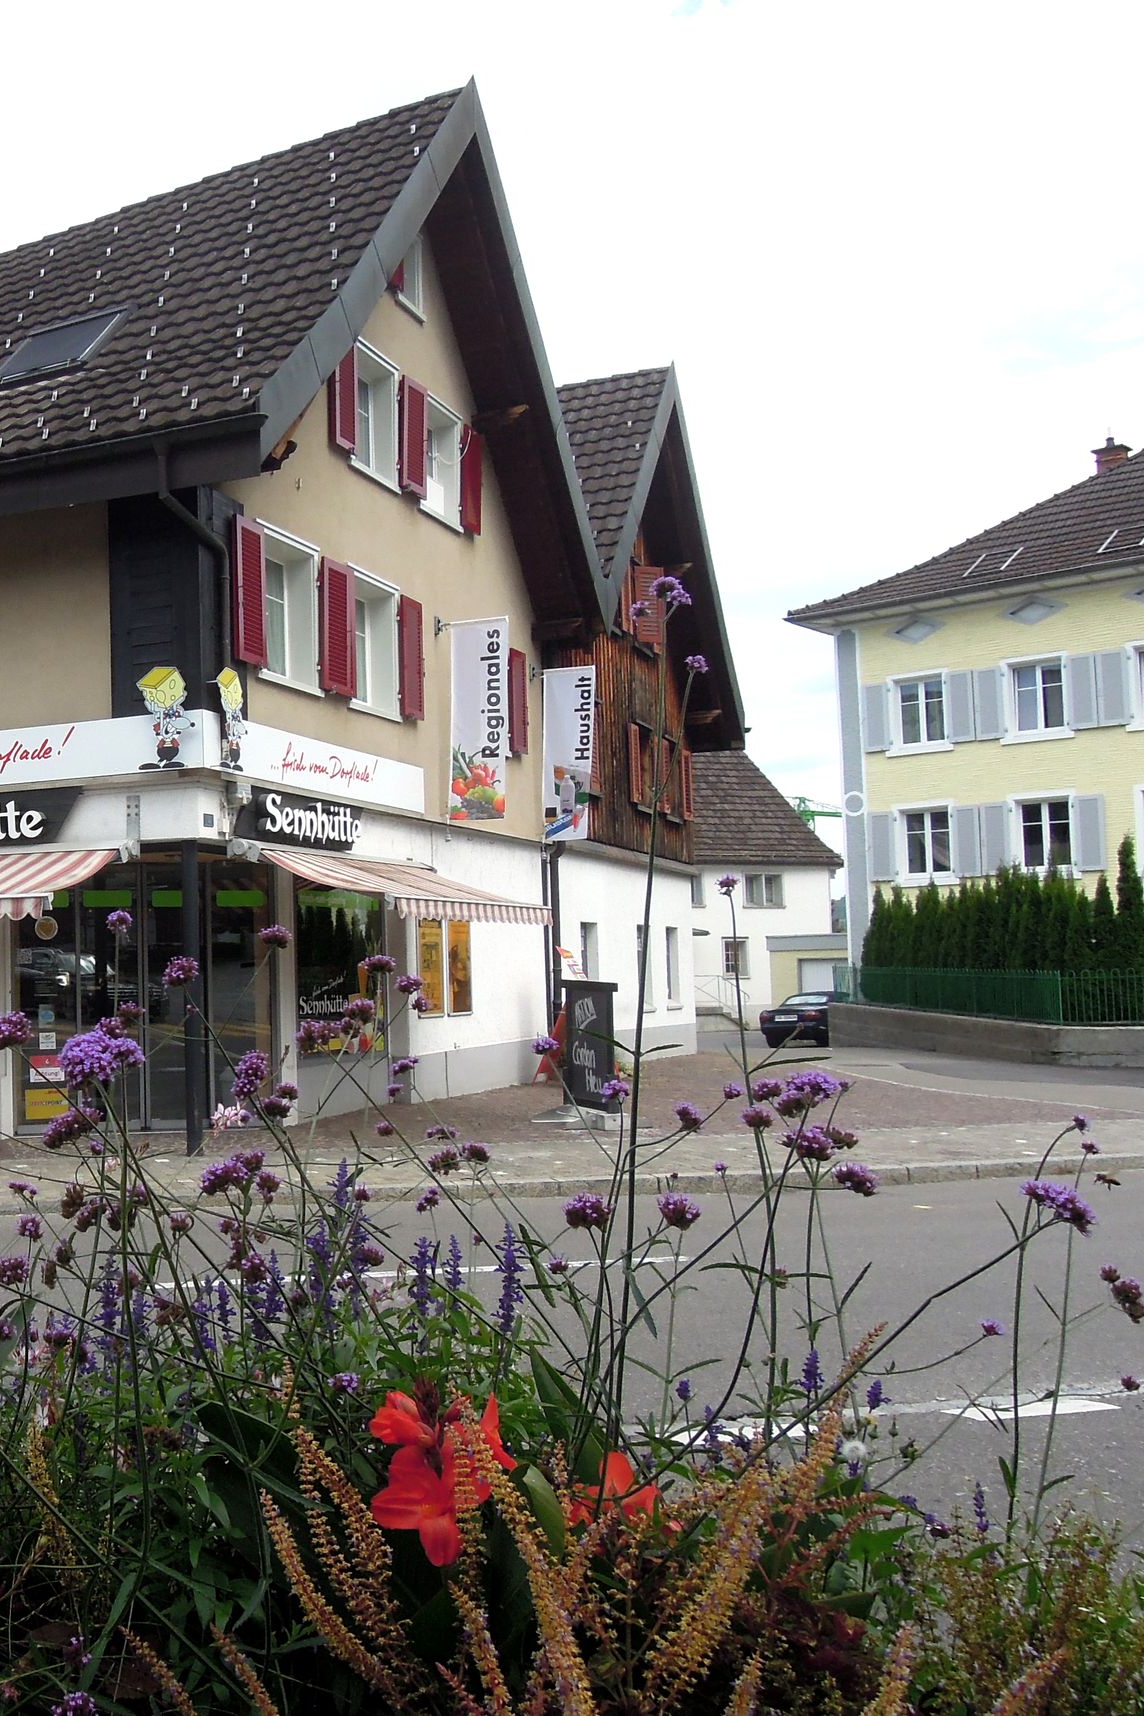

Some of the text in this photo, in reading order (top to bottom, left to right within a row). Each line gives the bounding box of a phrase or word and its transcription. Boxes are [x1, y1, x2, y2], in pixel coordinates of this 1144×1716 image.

[480, 628, 505, 759] Regionales
[574, 675, 592, 761] Haushalt
[309, 762, 329, 775] vom
[265, 793, 362, 844] Sennhütte
[299, 994, 348, 1016] Sennhütte
